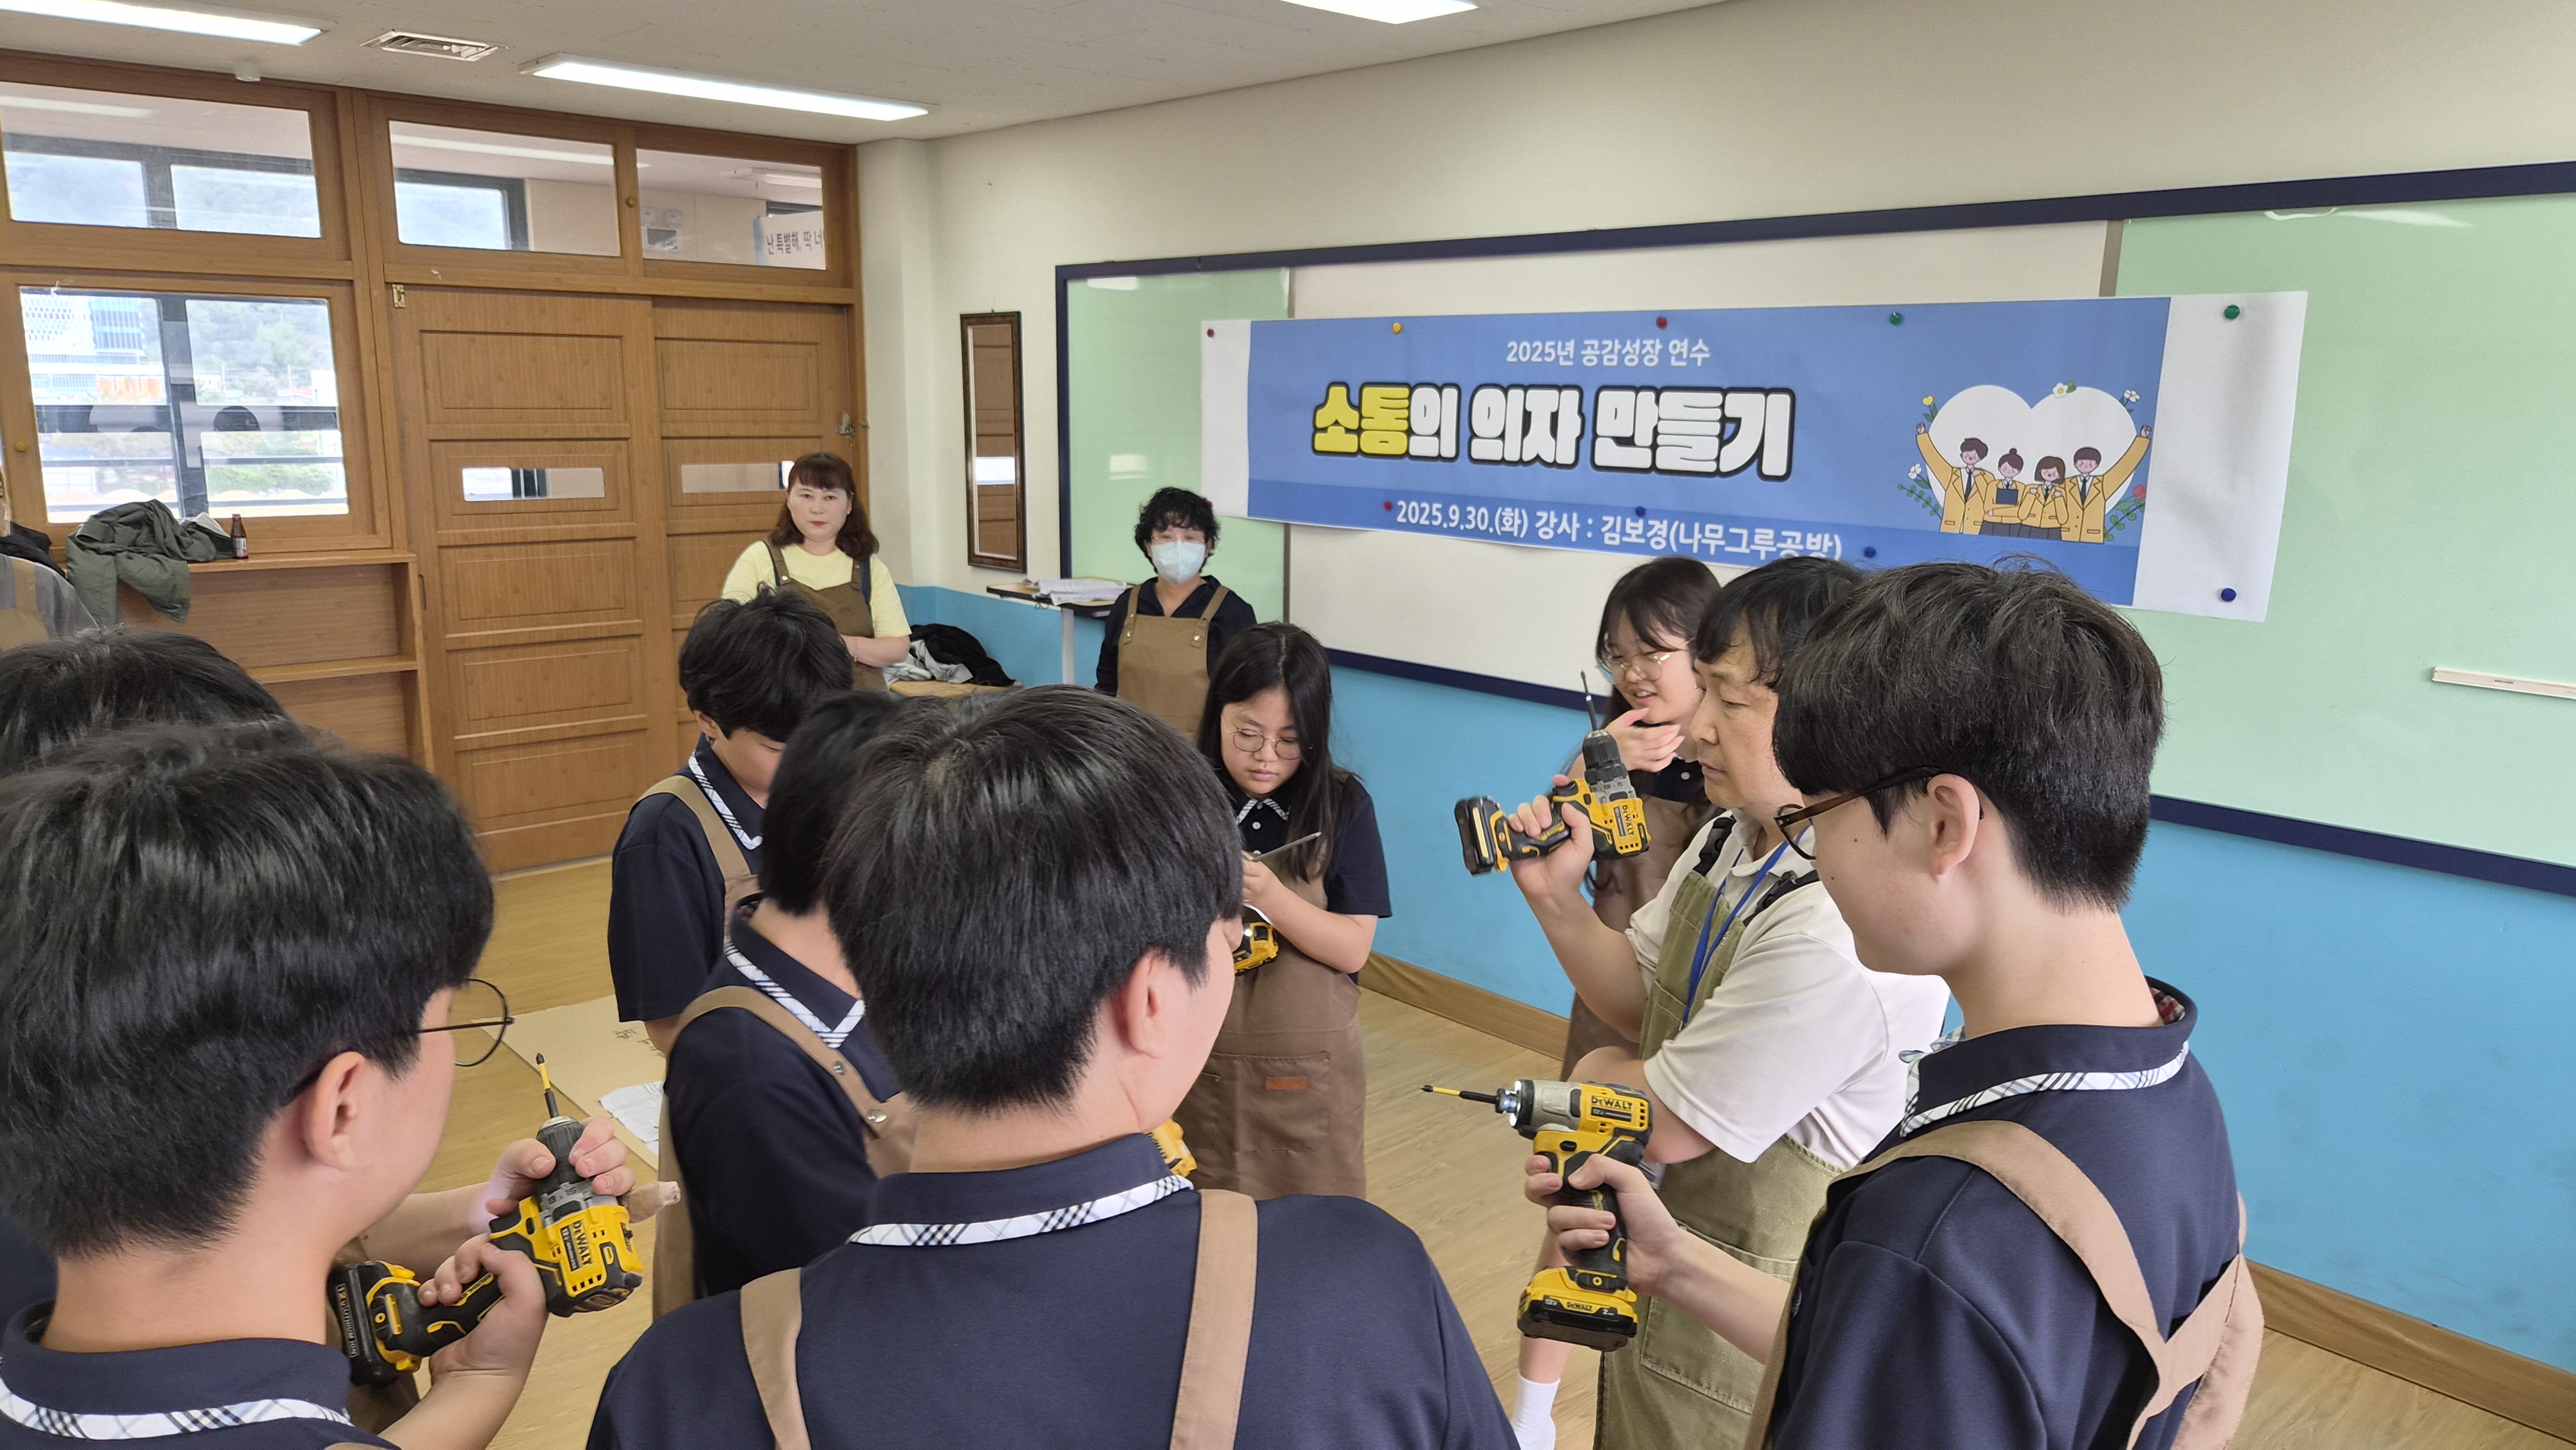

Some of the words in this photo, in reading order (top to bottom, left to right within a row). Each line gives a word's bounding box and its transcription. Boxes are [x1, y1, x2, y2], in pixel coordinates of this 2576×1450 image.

[1506, 339, 1575, 367] 2025년
[1580, 339, 1663, 368] 공감성장
[1668, 338, 1711, 368] 연수
[1314, 384, 1459, 459] 소통의
[1470, 386, 1582, 466] 의자
[1593, 389, 1792, 478] 만들기
[1396, 500, 1528, 538] 2025.9.30.(화)
[1535, 511, 1580, 542] 강사
[1587, 518, 1593, 538] :
[1601, 515, 1842, 561] 김보경(나무그루공방)
